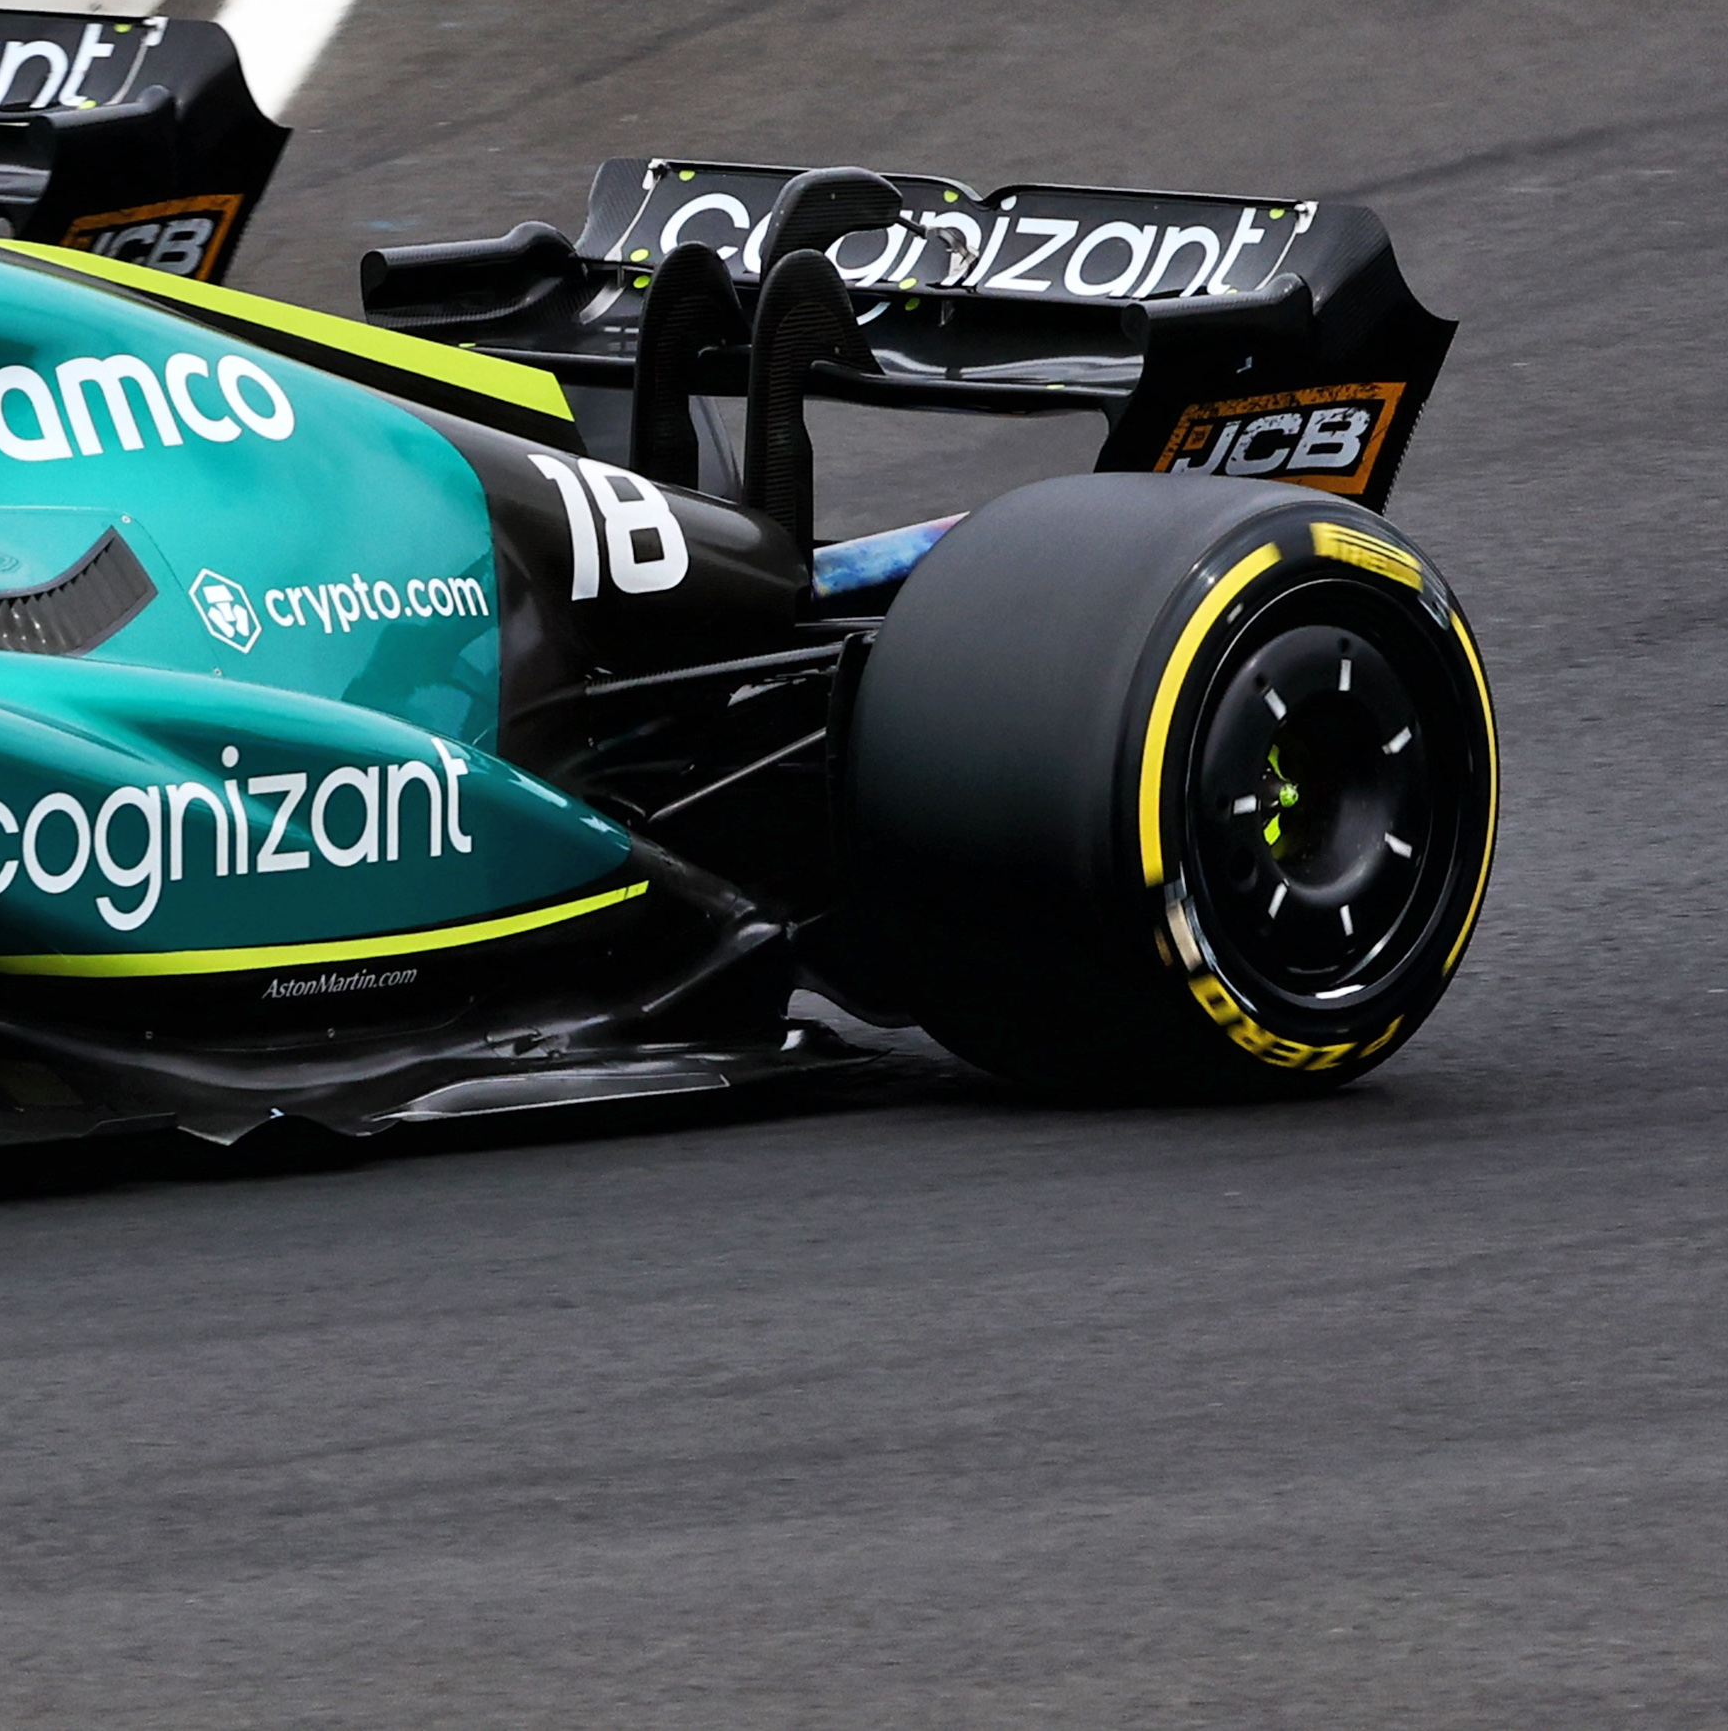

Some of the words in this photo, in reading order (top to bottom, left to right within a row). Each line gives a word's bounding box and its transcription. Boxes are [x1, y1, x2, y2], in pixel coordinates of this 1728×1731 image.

[1170, 407, 1371, 476] JCB
[529, 453, 689, 601] 18
[264, 572, 490, 634] crypto.com
[261, 965, 418, 1001] AstonMartin.com
